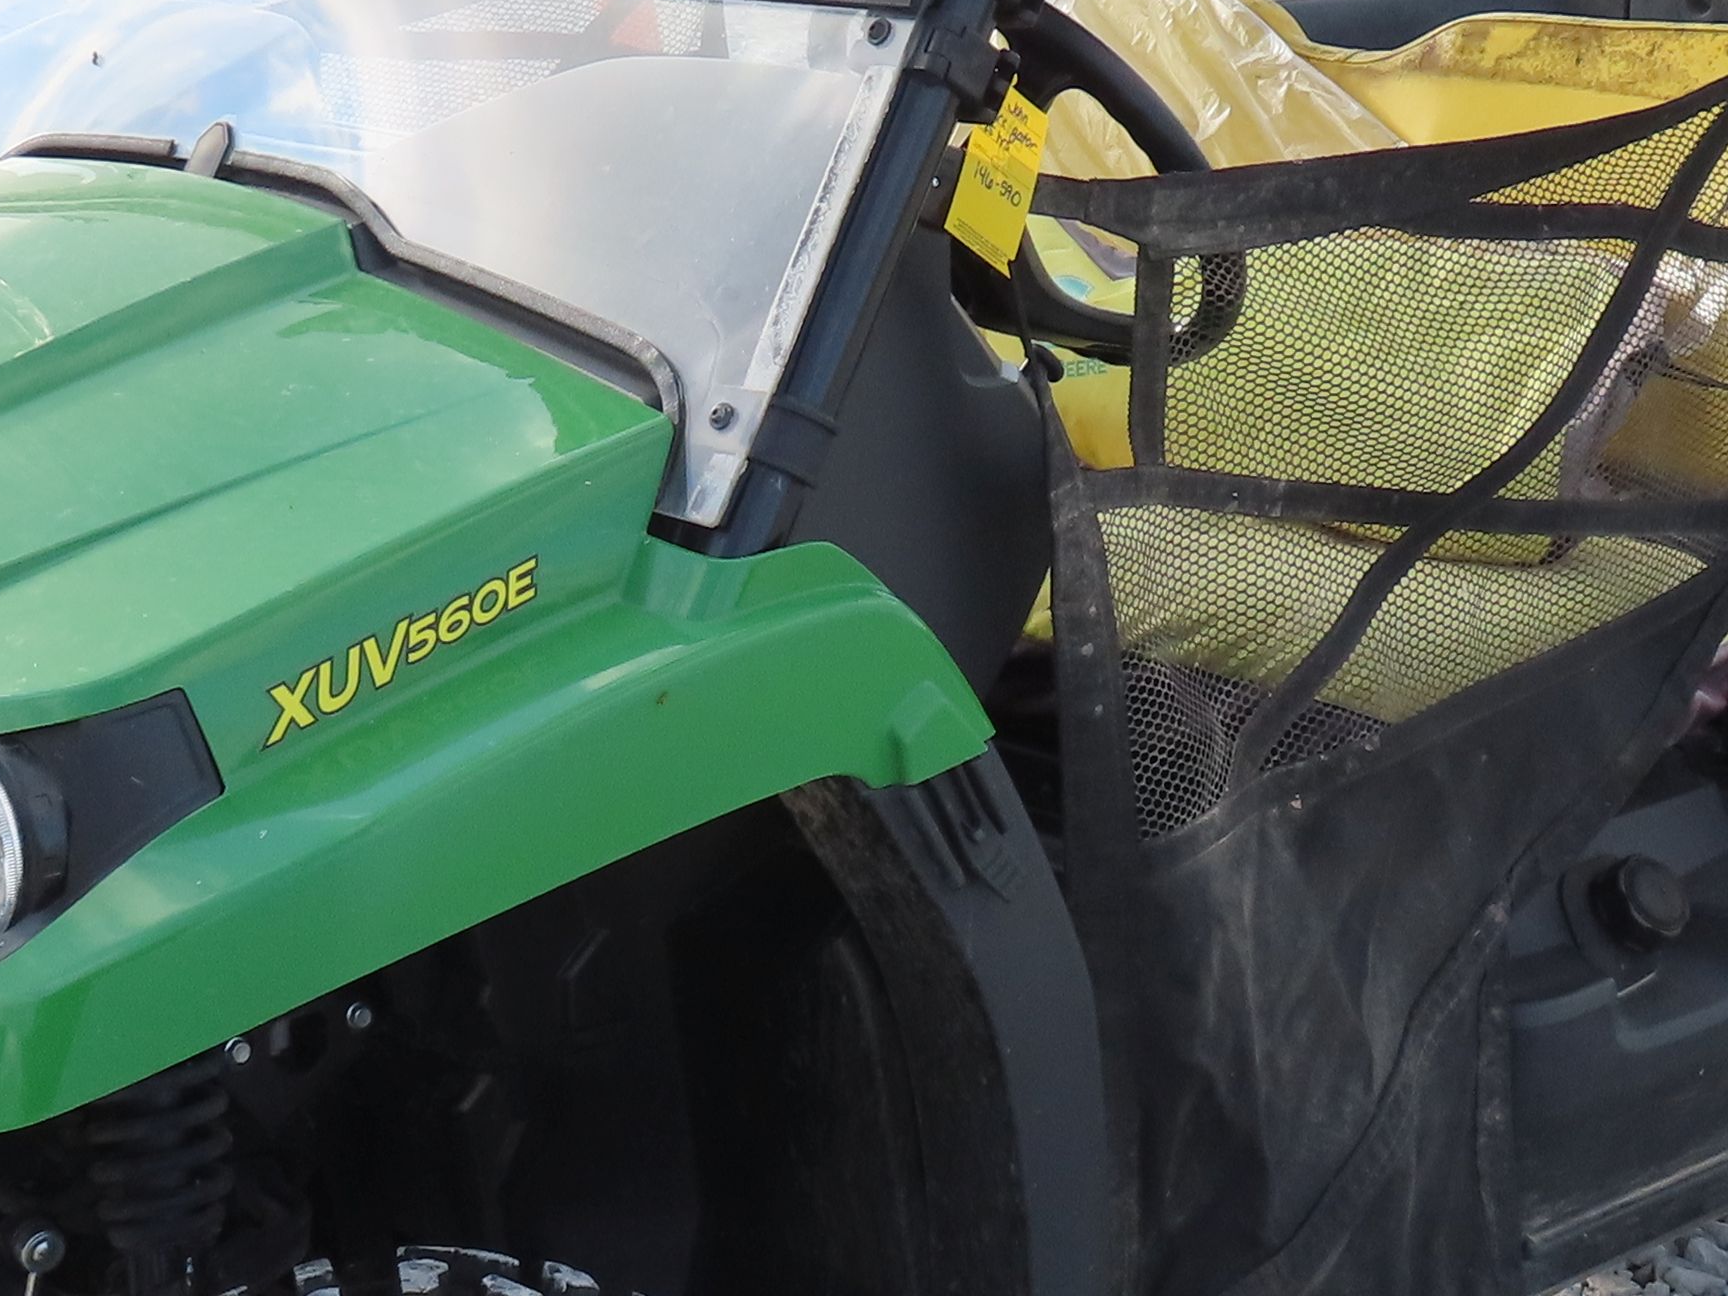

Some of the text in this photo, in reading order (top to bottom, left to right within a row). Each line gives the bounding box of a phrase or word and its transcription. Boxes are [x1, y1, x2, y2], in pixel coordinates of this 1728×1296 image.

[974, 161, 1022, 207] 146-590
[1062, 357, 1108, 378] EERE
[261, 554, 538, 751] XUV560E
